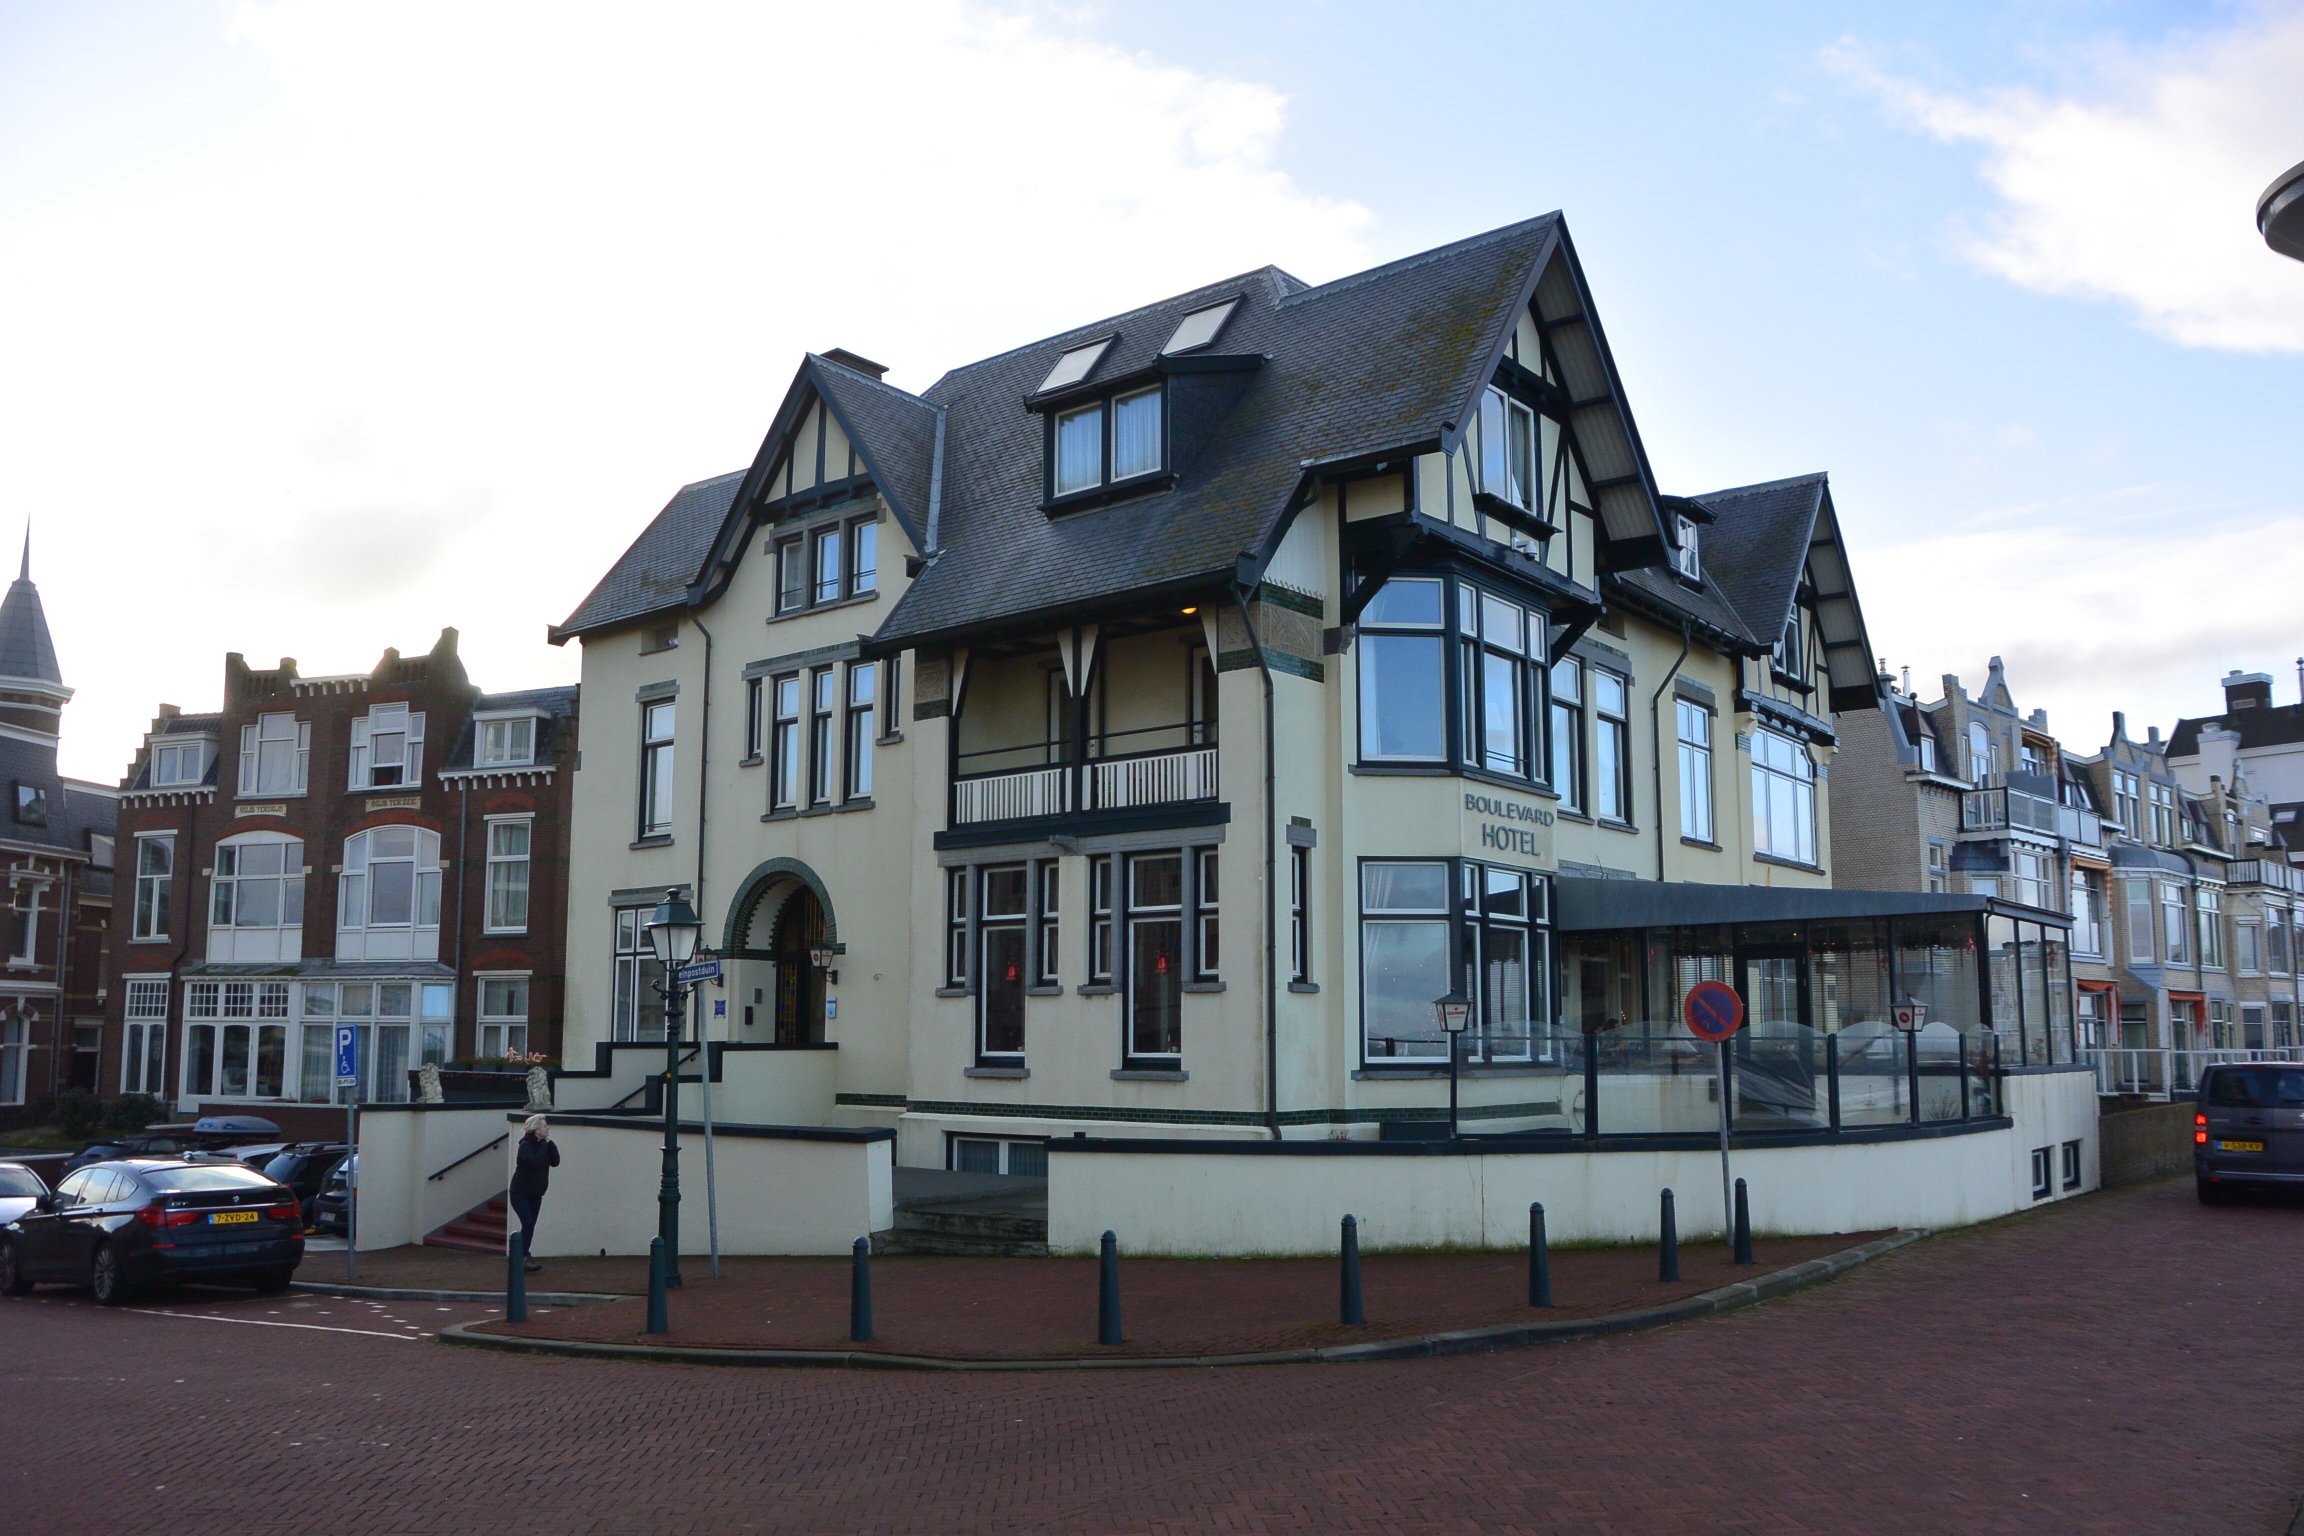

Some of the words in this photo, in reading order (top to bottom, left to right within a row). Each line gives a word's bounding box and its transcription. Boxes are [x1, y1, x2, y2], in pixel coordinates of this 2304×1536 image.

[1465, 793, 1555, 827] BOULEVARD
[1482, 823, 1541, 856] HOTEL
[678, 965, 715, 979] einpostduin
[340, 1030, 351, 1055] P
[217, 1212, 255, 1223] 7-ZVD-24
